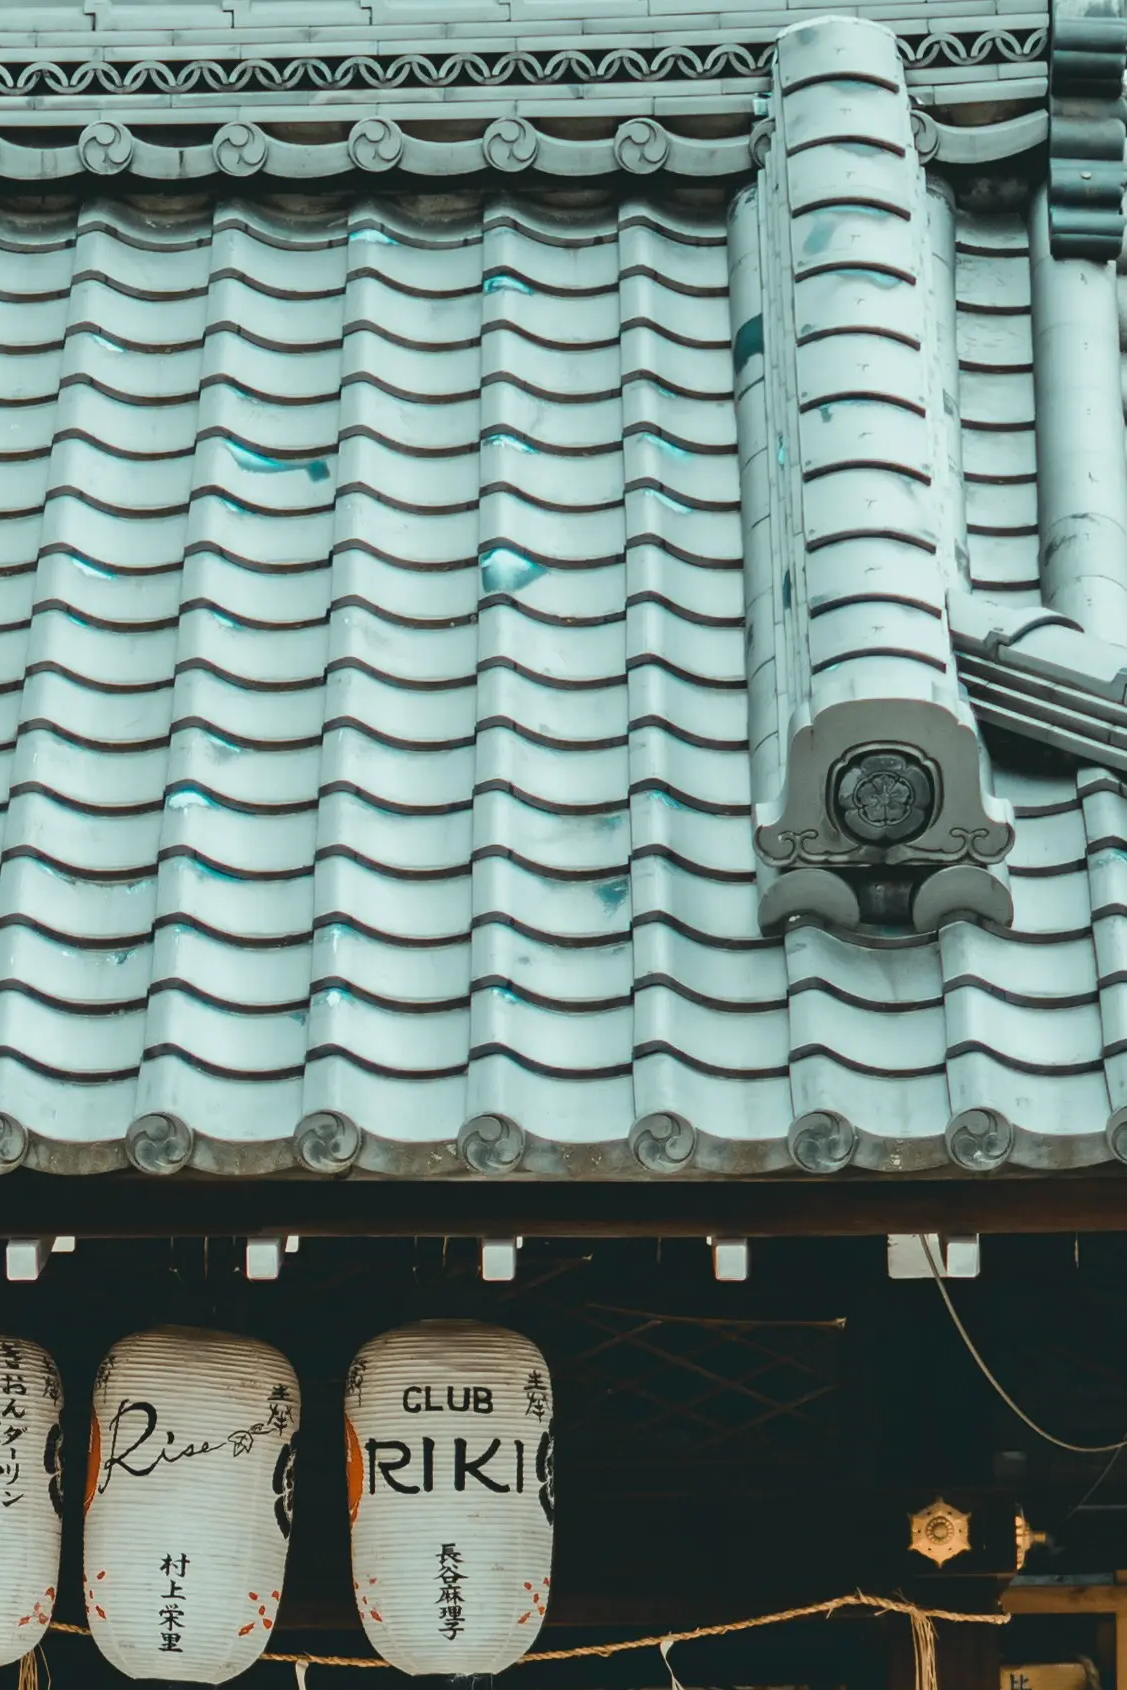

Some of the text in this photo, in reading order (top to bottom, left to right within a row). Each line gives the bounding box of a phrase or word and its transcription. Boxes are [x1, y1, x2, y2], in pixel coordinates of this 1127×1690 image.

[98, 1397, 228, 1496] Rise
[401, 1385, 495, 1415] CLUB
[364, 1436, 525, 1496] RIKI
[157, 1551, 192, 1654] 村上栄里
[433, 1541, 470, 1642] 長谷麻理子
